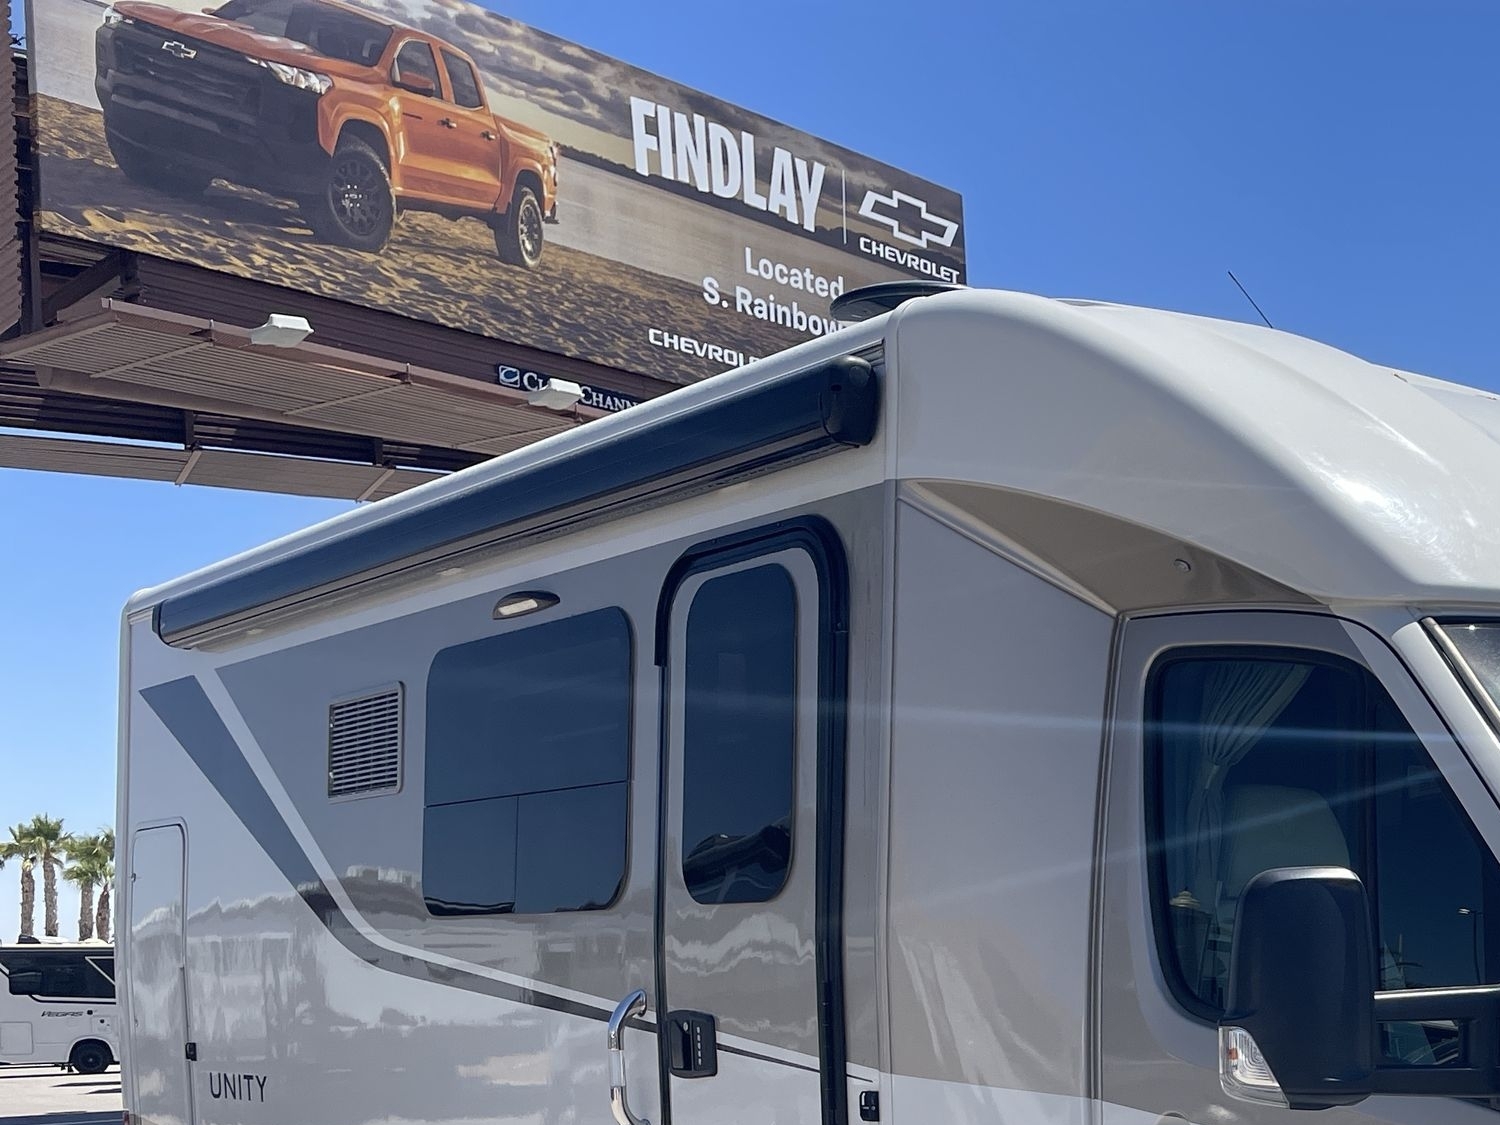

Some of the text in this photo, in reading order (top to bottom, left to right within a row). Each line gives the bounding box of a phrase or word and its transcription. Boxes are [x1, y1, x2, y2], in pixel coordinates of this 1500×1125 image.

[629, 95, 826, 233] FINDLAY
[744, 246, 847, 301] Located
[859, 236, 960, 285] CHEVROLET
[702, 276, 729, 309] S.
[208, 1072, 269, 1103] UNITY
